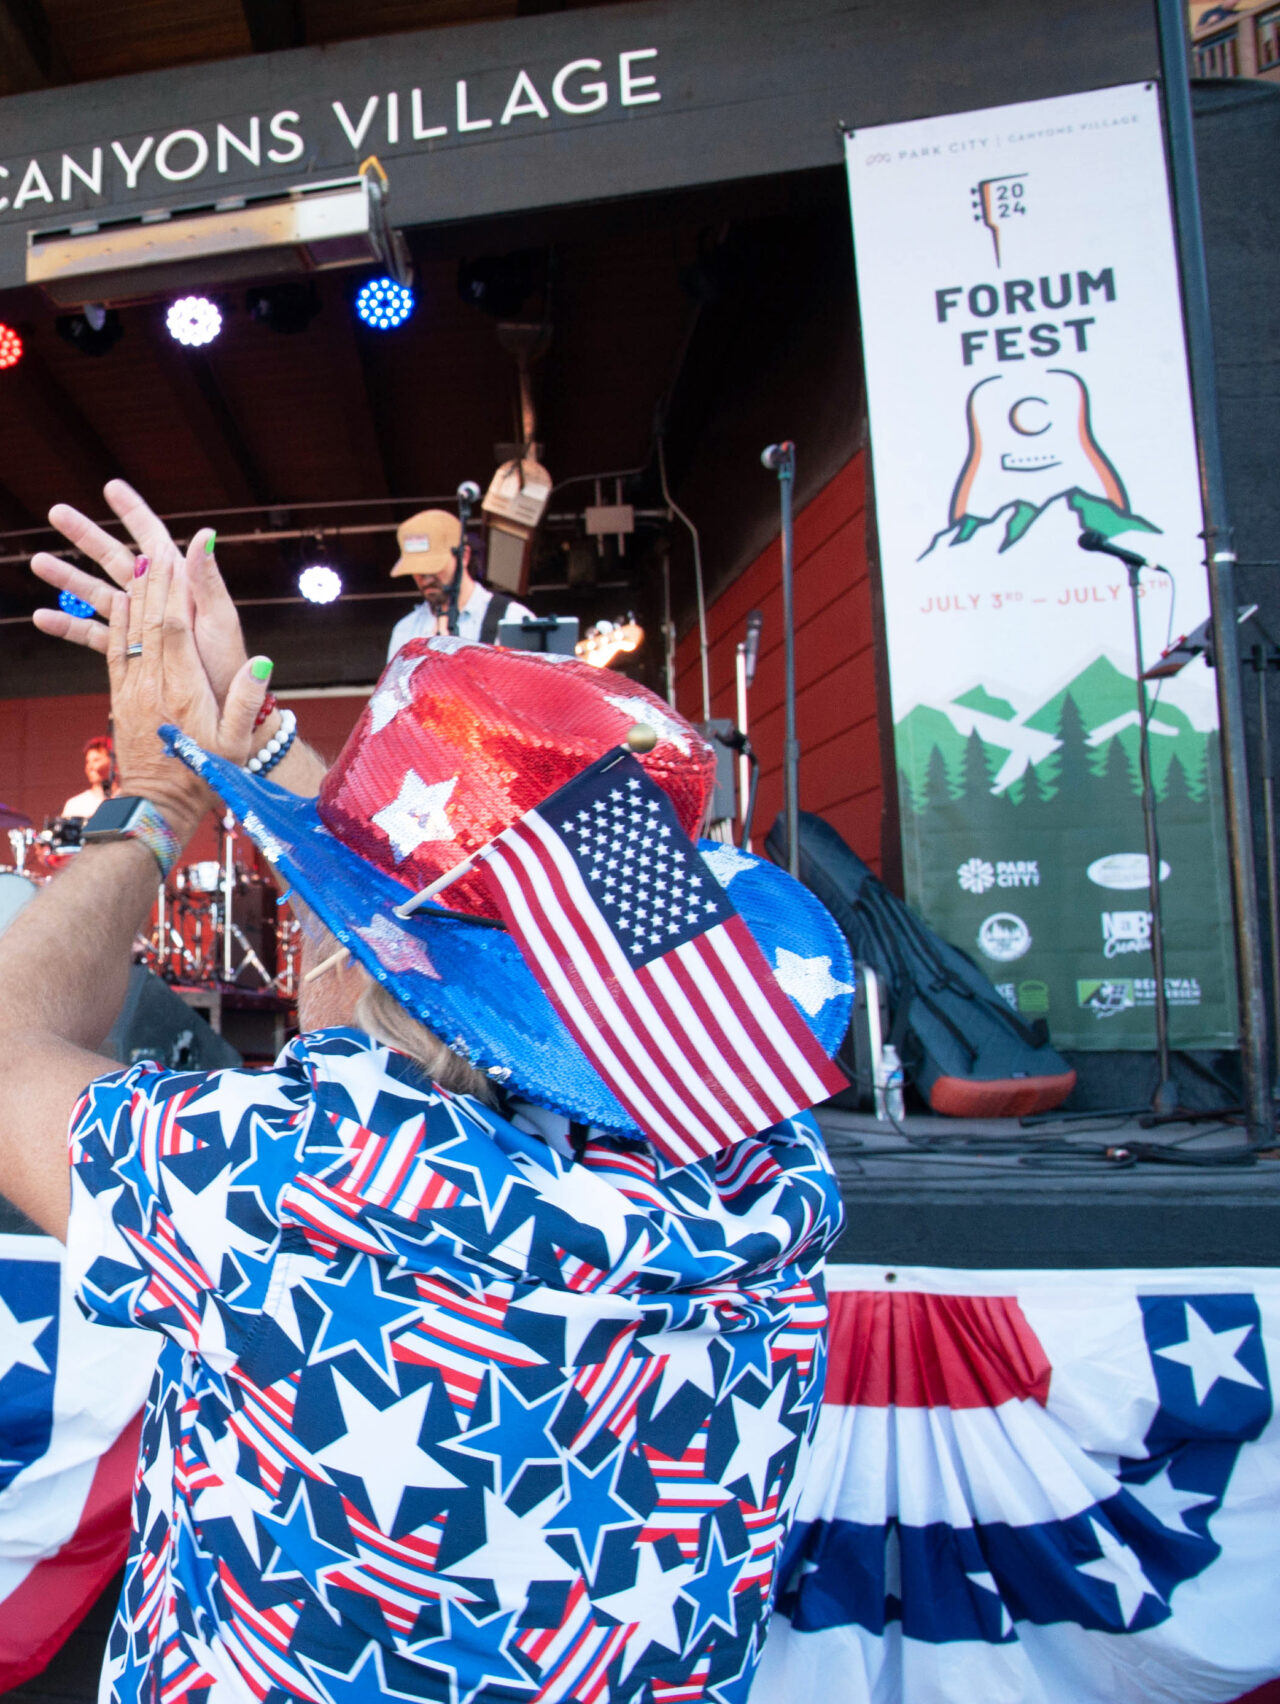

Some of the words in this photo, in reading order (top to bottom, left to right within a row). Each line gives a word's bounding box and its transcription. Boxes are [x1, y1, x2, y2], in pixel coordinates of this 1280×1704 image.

[331, 48, 662, 150] VILLAGE
[898, 145, 941, 161] PARK
[948, 138, 990, 154] CITY
[995, 183, 1025, 201] 20
[997, 201, 1027, 219] 24
[935, 267, 1117, 324] FORUM
[960, 317, 1096, 366] FEST
[919, 593, 981, 614] JULY
[1057, 584, 1122, 606] JULY
[996, 861, 1038, 874] PARK
[996, 874, 1032, 888] CITY
